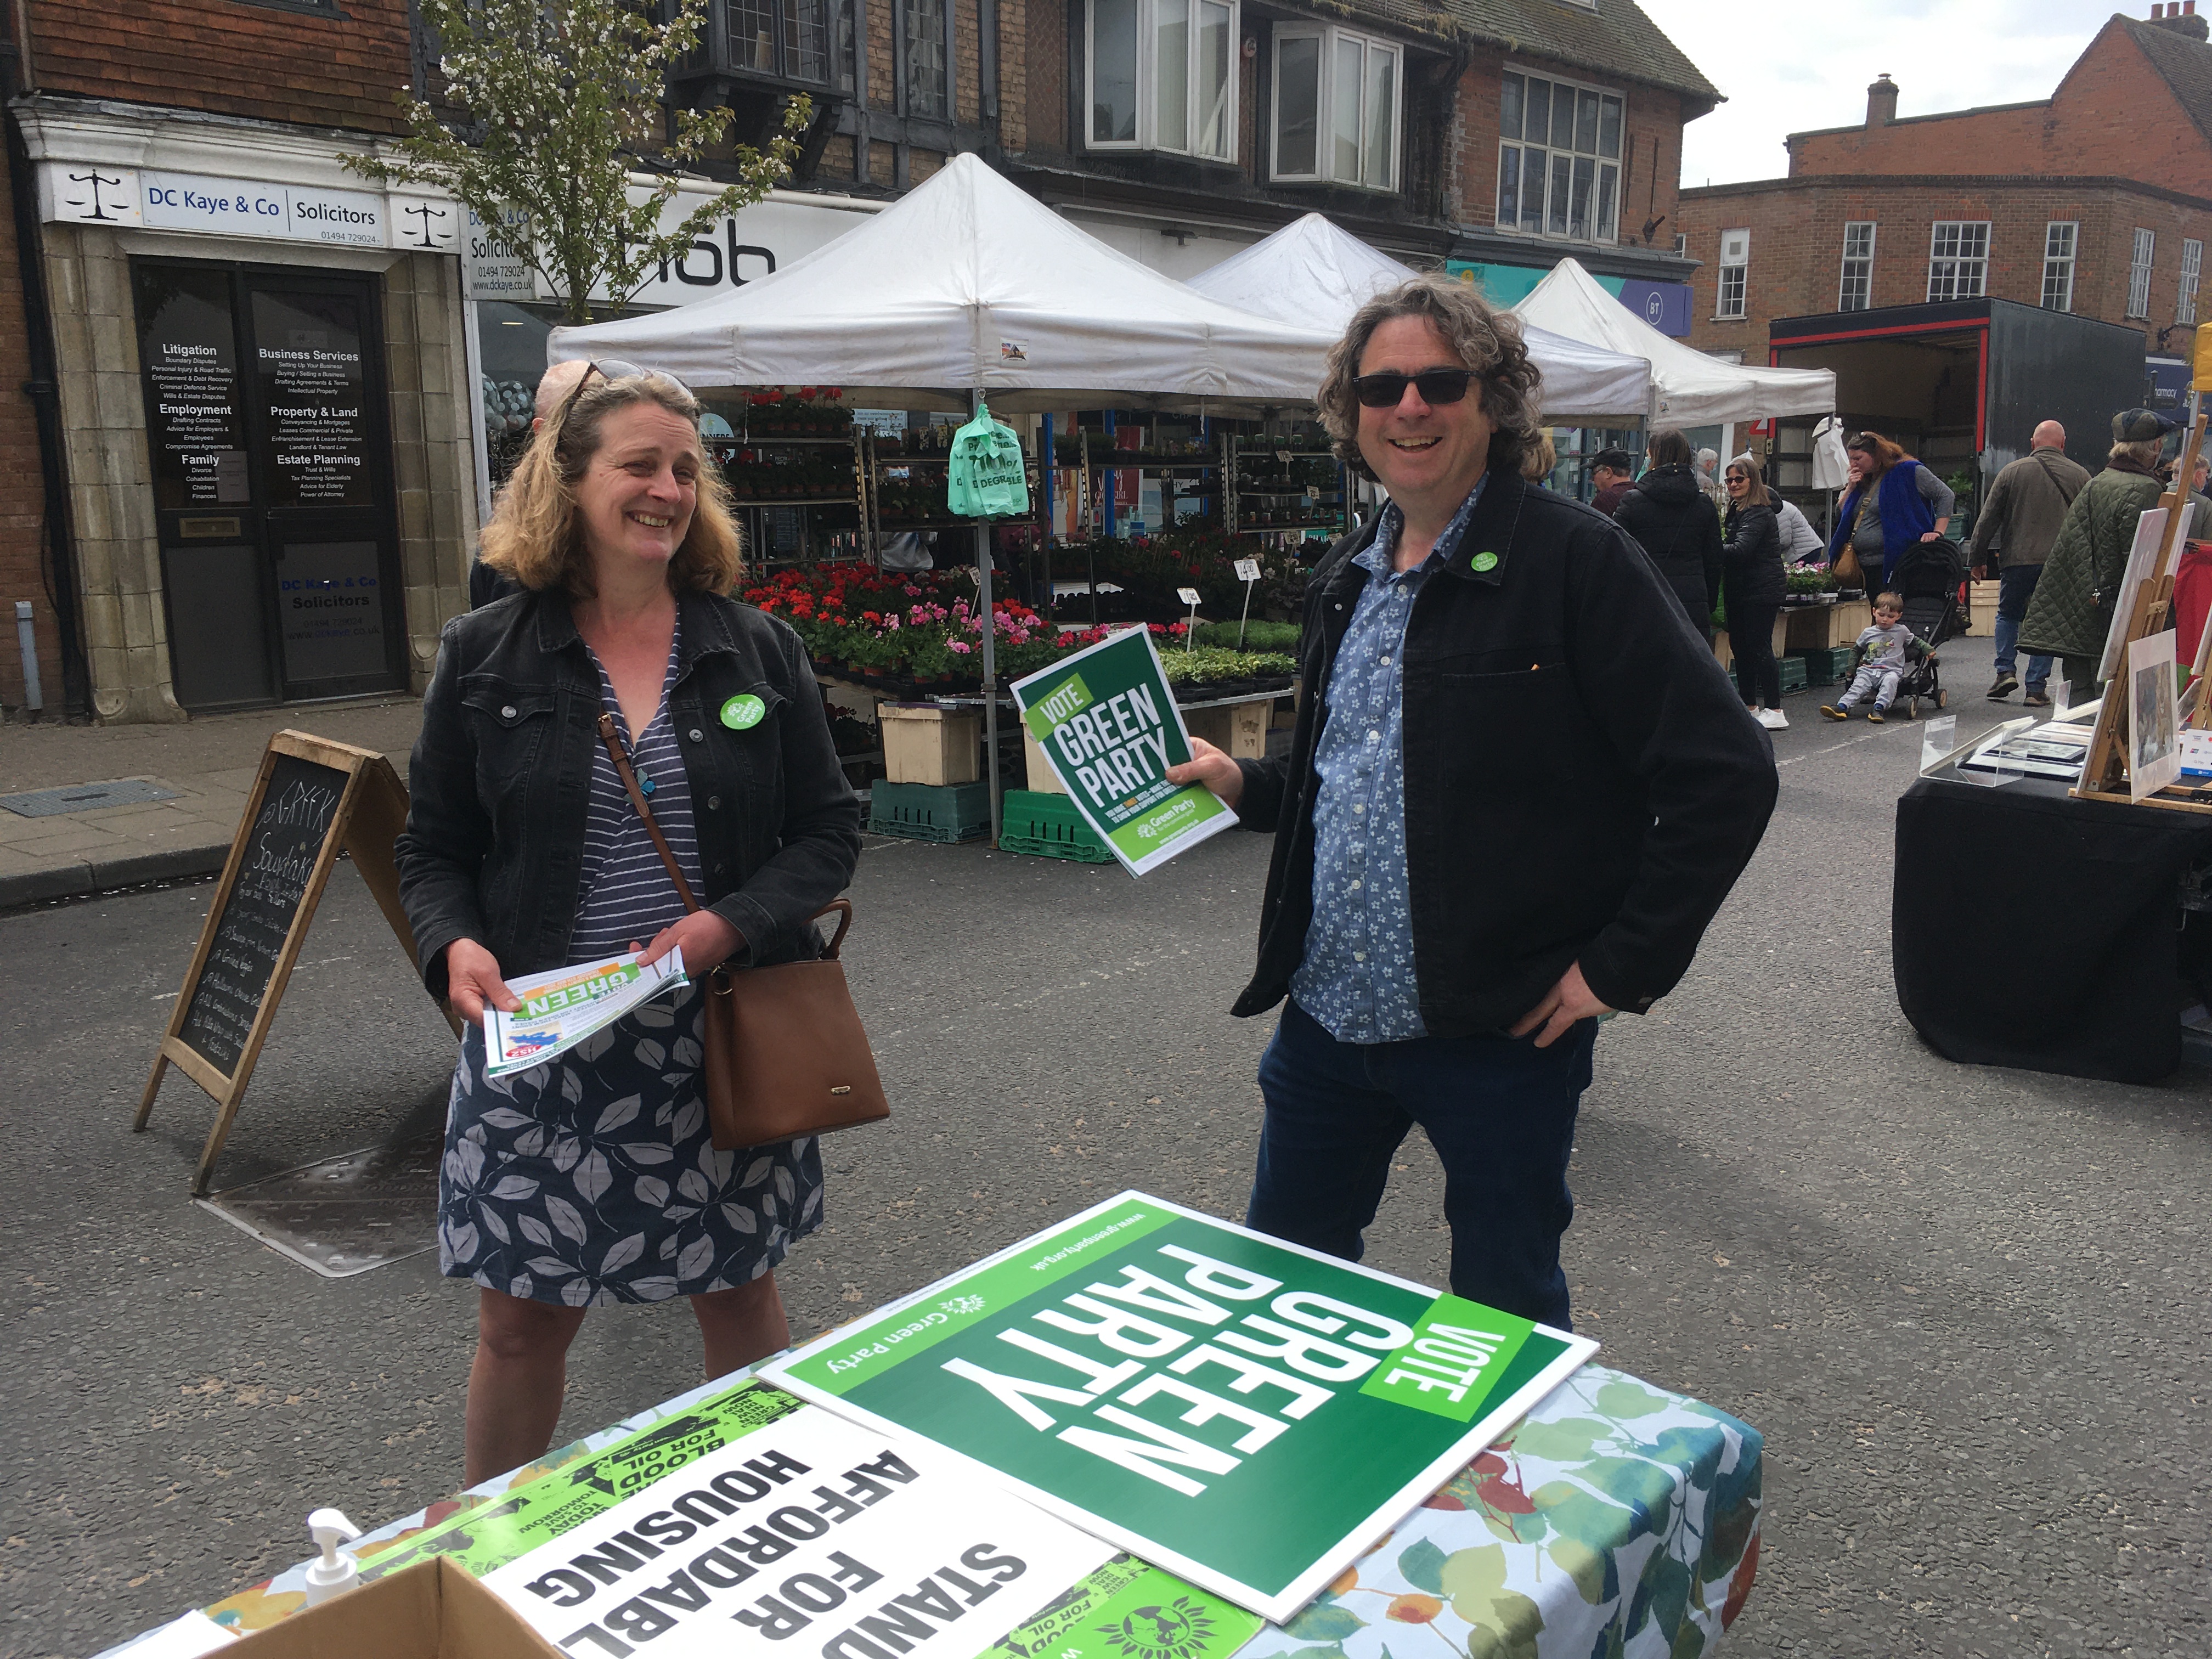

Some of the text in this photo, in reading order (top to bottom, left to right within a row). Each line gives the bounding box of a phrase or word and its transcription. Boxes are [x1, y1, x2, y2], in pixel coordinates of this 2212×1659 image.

[149, 188, 375, 225] DC Kaye & Co Solicitors
[516, 208, 529, 223] Co
[321, 231, 376, 244] 01494 729024
[478, 266, 525, 277] 01494 729024
[472, 279, 532, 293] www.dckaye.co.uk
[1650, 302, 1660, 314] BT
[162, 343, 217, 357] Litigation
[259, 348, 359, 361] Business Services
[160, 404, 232, 416] Employment
[270, 406, 358, 419] Property & Land
[182, 454, 219, 466] Family
[277, 455, 360, 466] Estate Planning
[281, 580, 301, 591] DC
[345, 577, 354, 588] &
[359, 576, 377, 587] Co
[293, 596, 370, 609] Solicitors
[737, 702, 754, 723] Green
[1040, 683, 1084, 724] VOTE
[745, 704, 763, 724] Party
[1053, 682, 1162, 766] GREEN
[1075, 726, 1171, 809] PARTY
[1150, 799, 1195, 827] Green Party
[526, 970, 630, 1015] GREEN
[511, 1046, 536, 1057] HS2
[1029, 1214, 1146, 1272] www.greenparty.org.uk
[826, 1312, 948, 1374] Green Party
[940, 1244, 1284, 1432] PARTY
[1384, 1323, 1506, 1403] VOTE
[1056, 1291, 1414, 1497] GREEN
[722, 1398, 752, 1414] NOW
[729, 1403, 760, 1415] DEAL
[736, 1404, 766, 1419] NEW
[738, 1406, 775, 1424] GREEN
[622, 1429, 716, 1470] FOR OIL
[619, 1437, 725, 1489] BLOOD
[518, 1490, 598, 1534] TOMORROW
[544, 1502, 589, 1527] TO SAVE
[549, 1503, 604, 1536] TODAY
[523, 1449, 813, 1606] HOUSING
[550, 1450, 920, 1659] AFFORDABL
[1088, 1569, 1109, 1585] NOW
[1096, 1573, 1115, 1587] DEAL
[1100, 1576, 1121, 1590] NEW
[1105, 1577, 1128, 1595] GREEN
[729, 1550, 885, 1641] FOR
[822, 1543, 1027, 1659] STAND
[1028, 1599, 1092, 1637] FOR OIL
